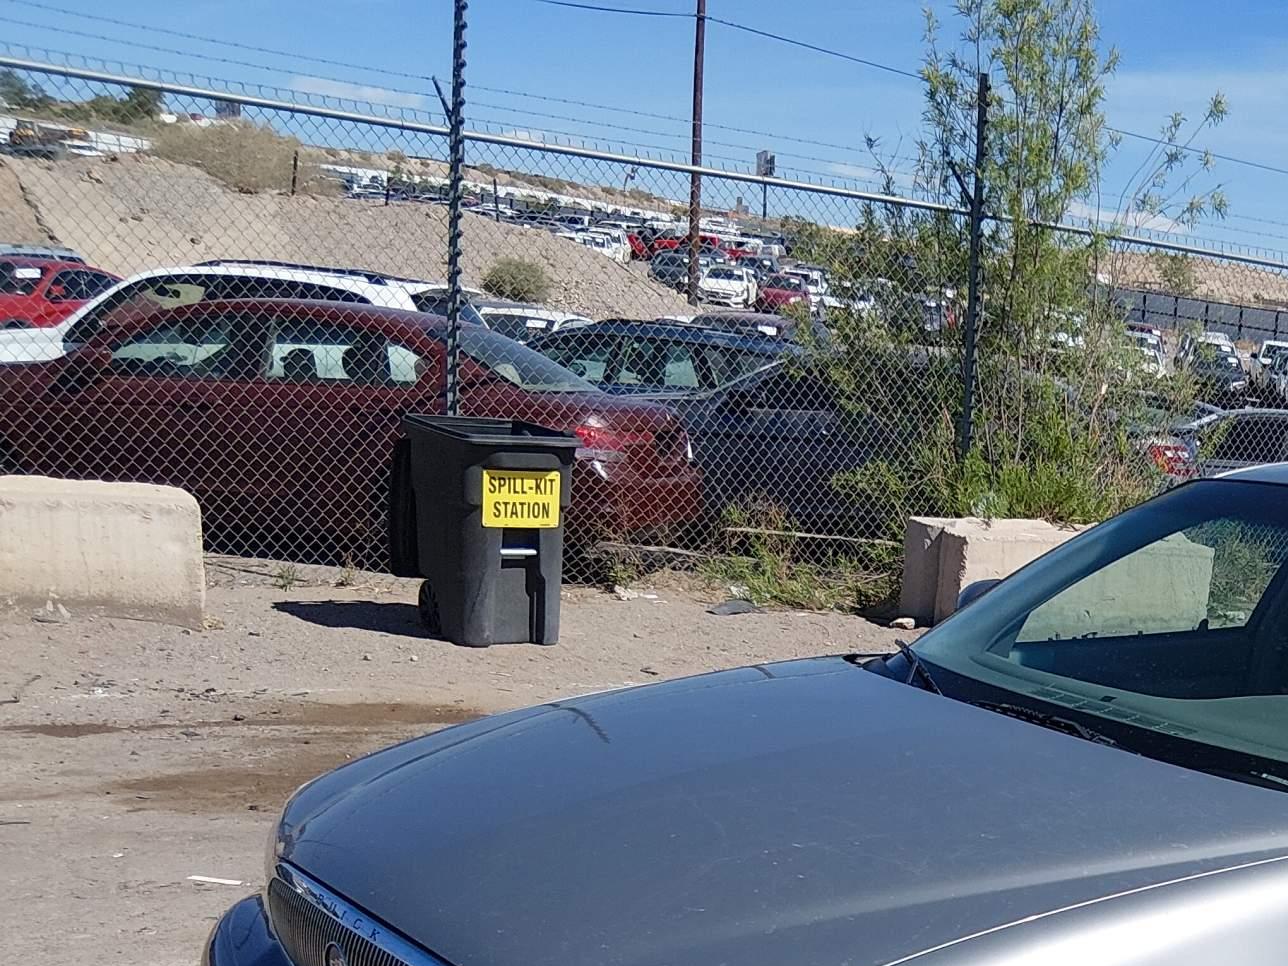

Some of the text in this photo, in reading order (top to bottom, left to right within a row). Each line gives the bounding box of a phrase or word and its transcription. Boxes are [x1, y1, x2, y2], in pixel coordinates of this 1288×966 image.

[488, 475, 556, 496] SPILL-KIT
[493, 500, 551, 519] STATION
[316, 893, 381, 942] BUICK
